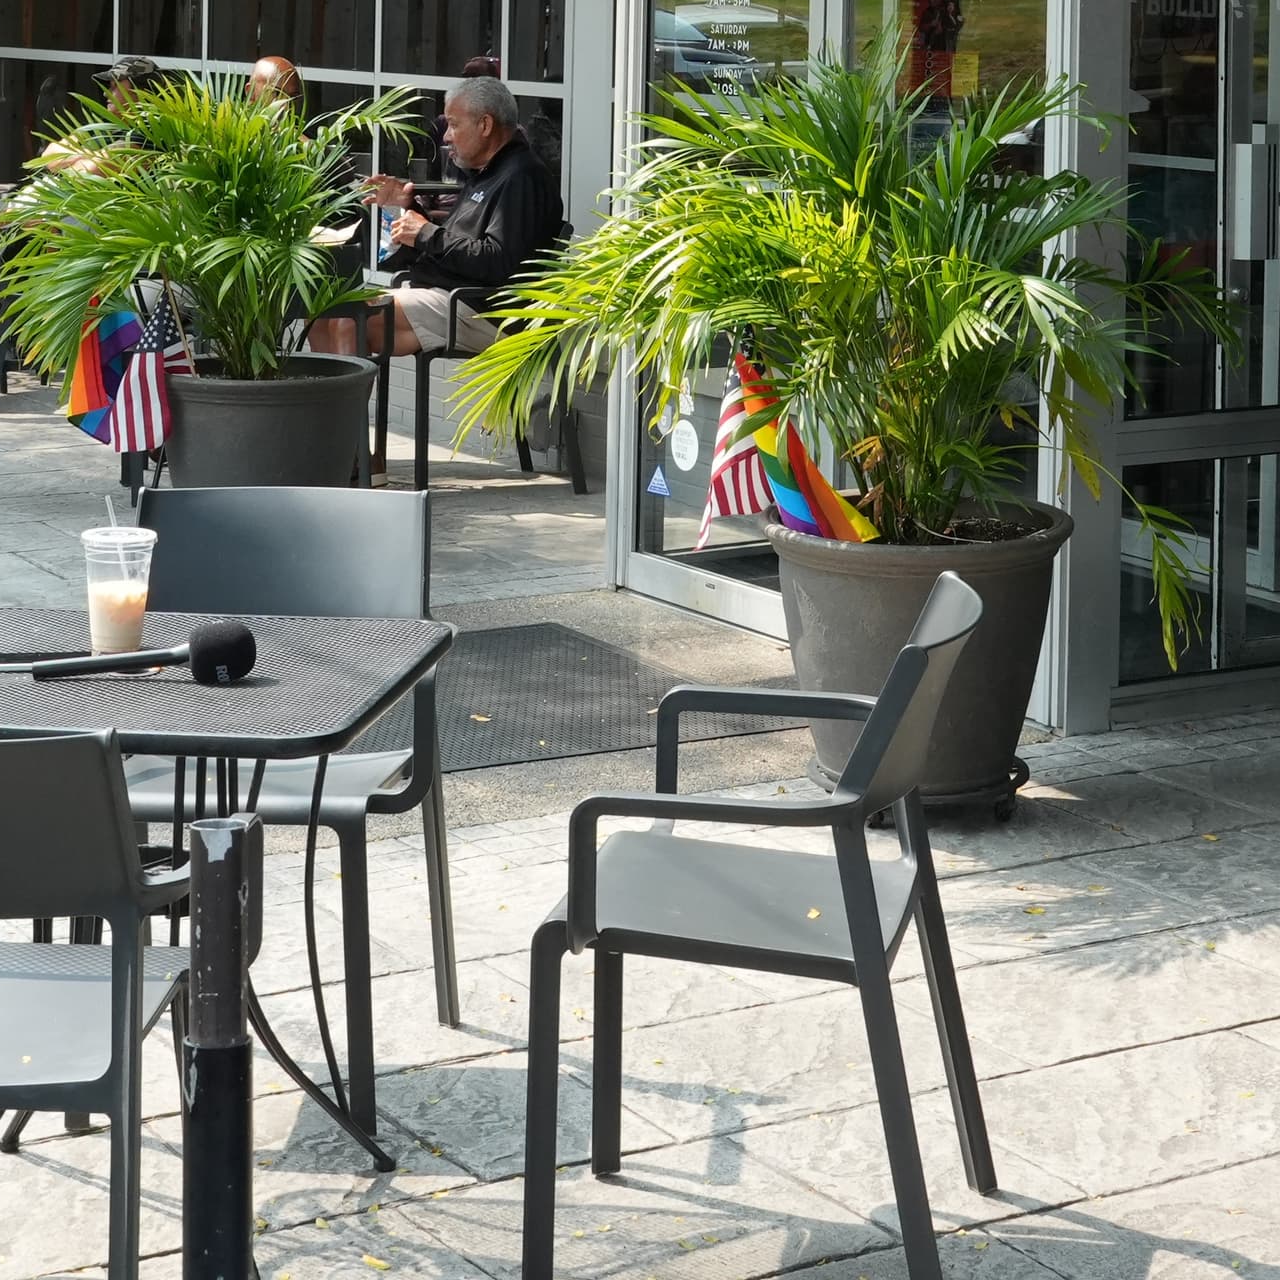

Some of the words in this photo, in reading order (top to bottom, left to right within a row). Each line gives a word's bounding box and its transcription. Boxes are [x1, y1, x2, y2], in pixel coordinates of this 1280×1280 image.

[710, 23, 748, 36] SATURDAY
[707, 39, 725, 50] 7AM
[713, 67, 743, 80] SUNDAY
